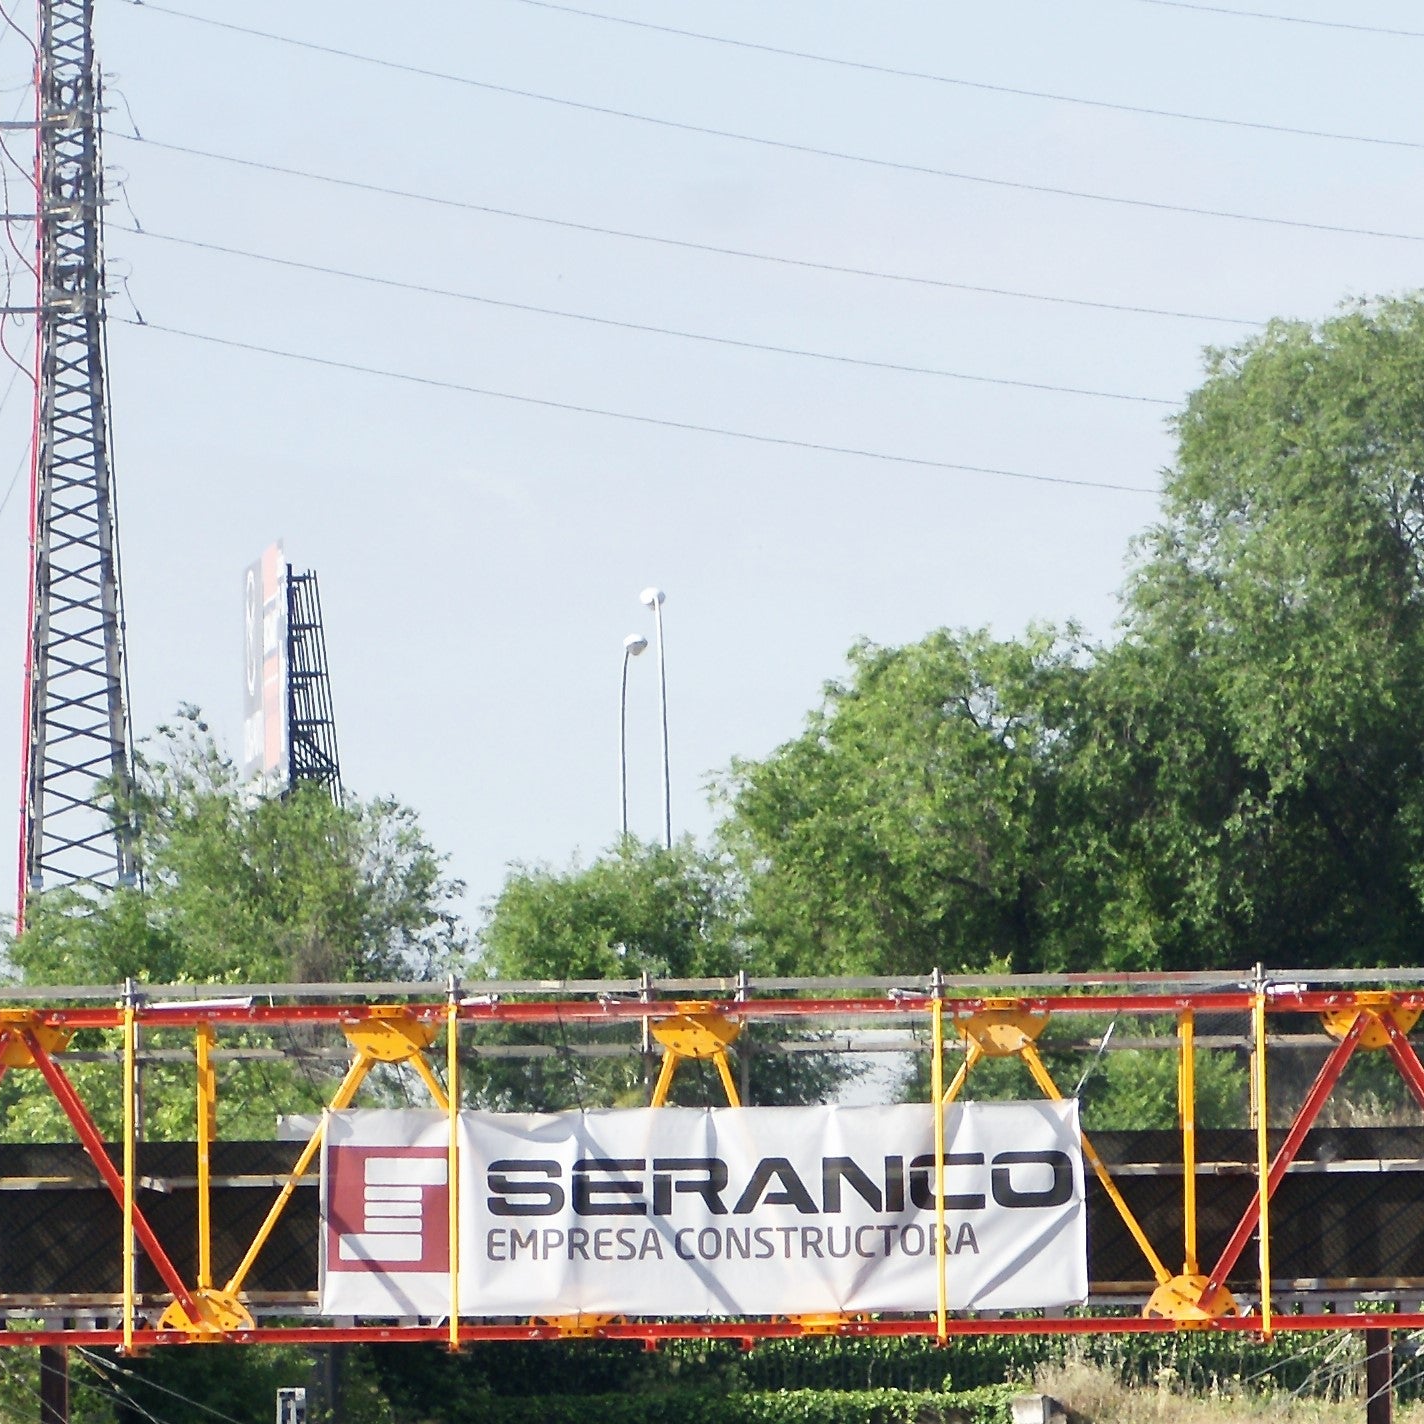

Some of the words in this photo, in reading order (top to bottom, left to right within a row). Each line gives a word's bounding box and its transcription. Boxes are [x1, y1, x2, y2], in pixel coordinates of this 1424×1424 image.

[487, 1150, 1074, 1216] SERANCO
[487, 1227, 664, 1261] EMPRESA
[676, 1222, 980, 1260] CONSTRUCTORA
